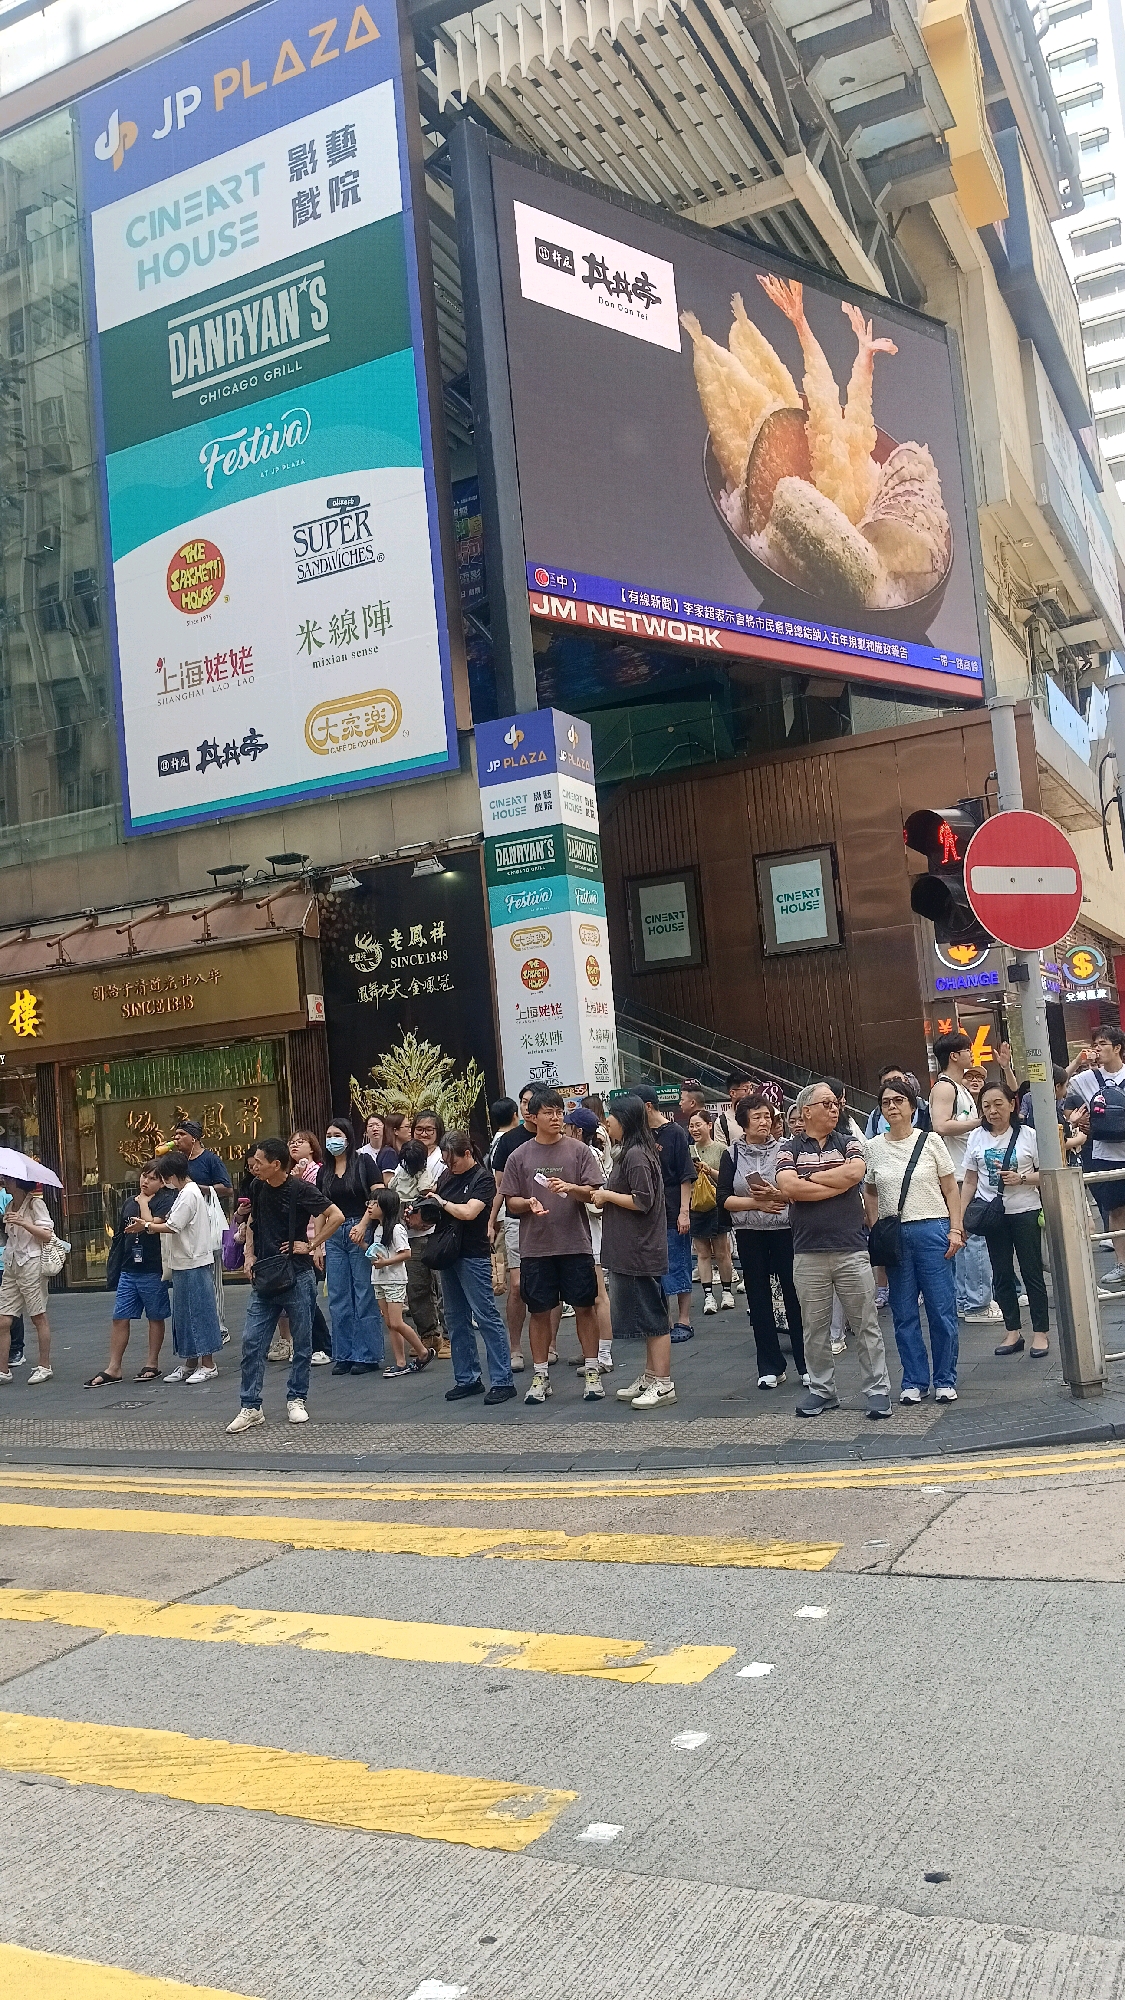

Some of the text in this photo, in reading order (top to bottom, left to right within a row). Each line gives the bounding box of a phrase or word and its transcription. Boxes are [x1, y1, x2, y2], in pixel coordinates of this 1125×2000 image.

[152, 4, 381, 140] JP PLAZA
[287, 123, 357, 183] 影藝
[125, 161, 266, 249] CINEART
[292, 170, 362, 229] 戲院
[138, 211, 260, 291] HOUSE
[598, 296, 615, 309] Don
[636, 310, 648, 321] Tei
[199, 361, 303, 406] CHICAGO GRILL
[199, 407, 312, 490] Festiva
[282, 459, 306, 471] PLAZA
[293, 509, 373, 558] SUPER
[180, 543, 205, 564] THE
[297, 544, 374, 580] SANDWICHES
[181, 584, 216, 610] HOUSE
[295, 599, 393, 656] 米線陣
[532, 595, 724, 649] JM NETWORK
[312, 644, 379, 669] mixian sense
[157, 646, 254, 696] 上海姥姥
[157, 675, 255, 707] SHANGHAI LAO LAO
[486, 750, 548, 773] JP PLAZA
[568, 753, 591, 772] PLAZA
[489, 794, 528, 810] CINEART
[492, 806, 527, 821] HOUSE
[505, 886, 553, 914] Festiva
[776, 887, 821, 904] CINEART
[780, 900, 820, 915] HOUSE
[644, 910, 686, 925] CINEART
[648, 922, 685, 936] HOUSE
[388, 920, 447, 952] 老鳳祥
[390, 949, 449, 969] SINCE1848
[935, 971, 999, 991] CHANGE
[8, 989, 40, 1038] 樓
[529, 1065, 558, 1080] SUPER
